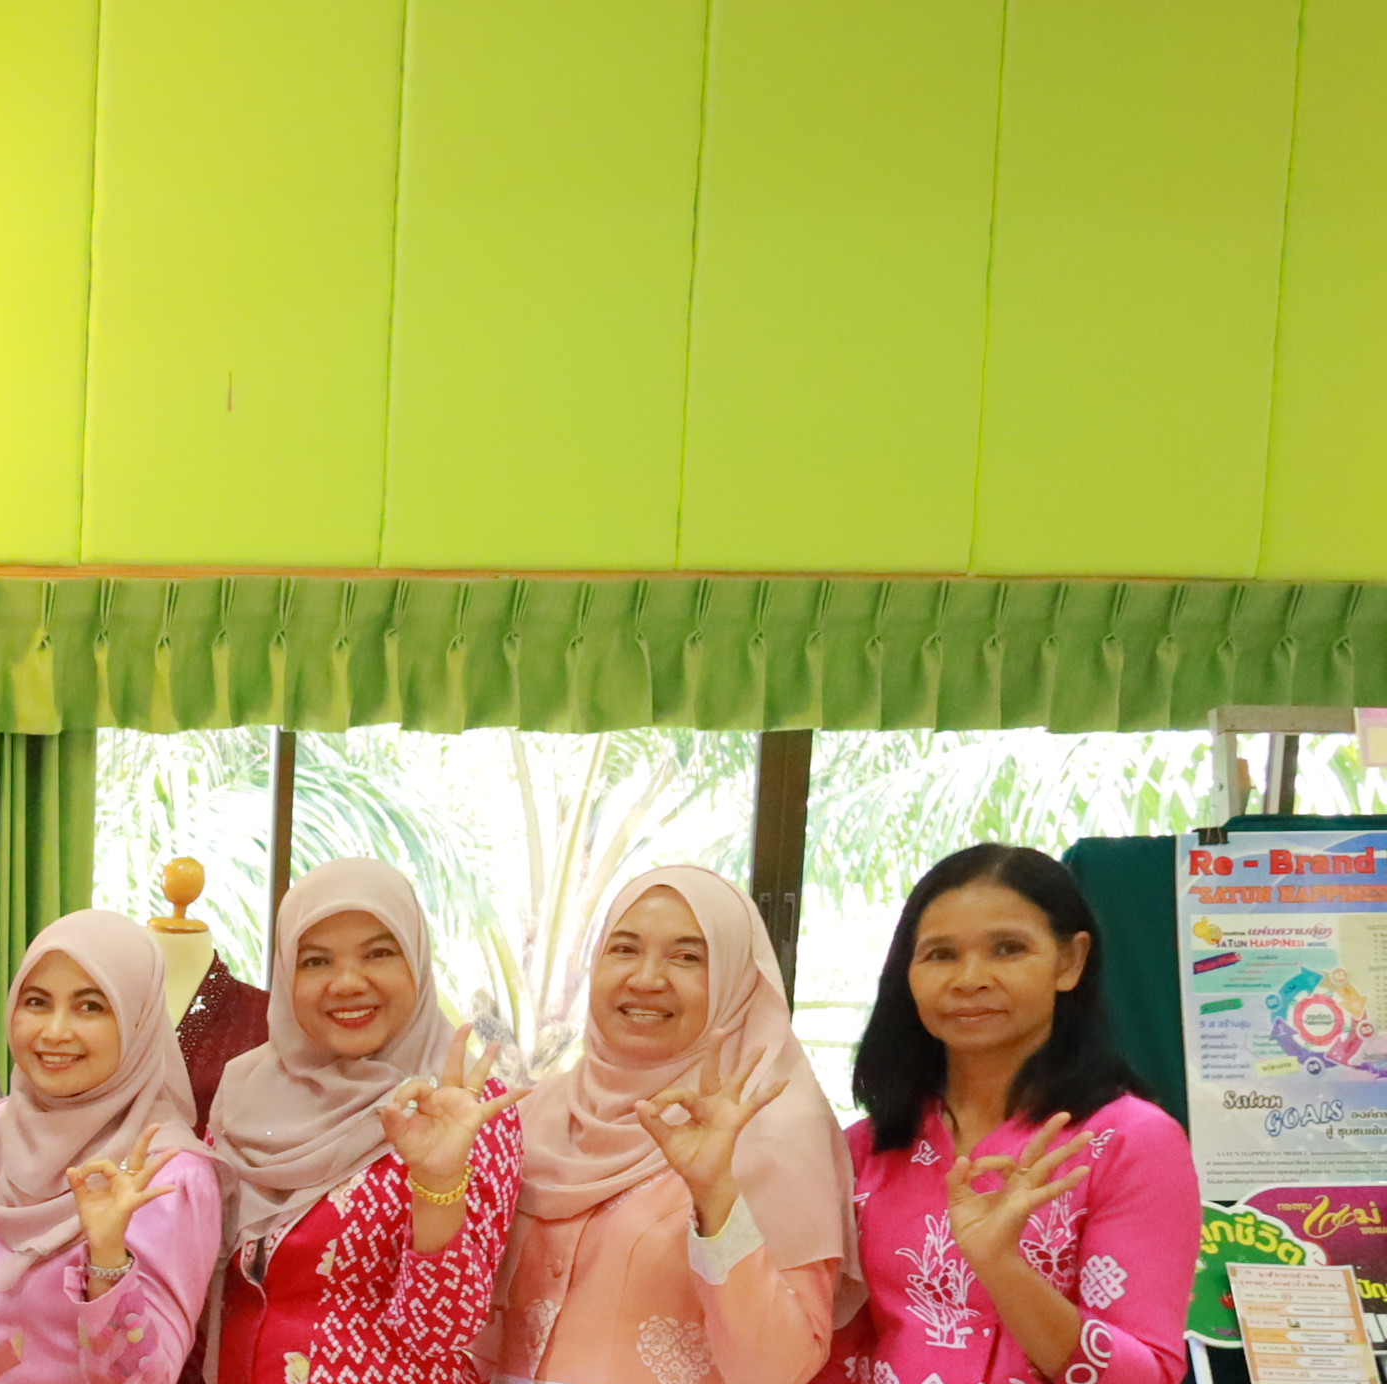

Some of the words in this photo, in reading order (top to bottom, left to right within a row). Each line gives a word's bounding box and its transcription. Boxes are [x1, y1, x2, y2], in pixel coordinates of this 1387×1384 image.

[1268, 846, 1377, 876] Brand
[1222, 1090, 1283, 1110] Satun
[1264, 1099, 1345, 1137] GOALS
